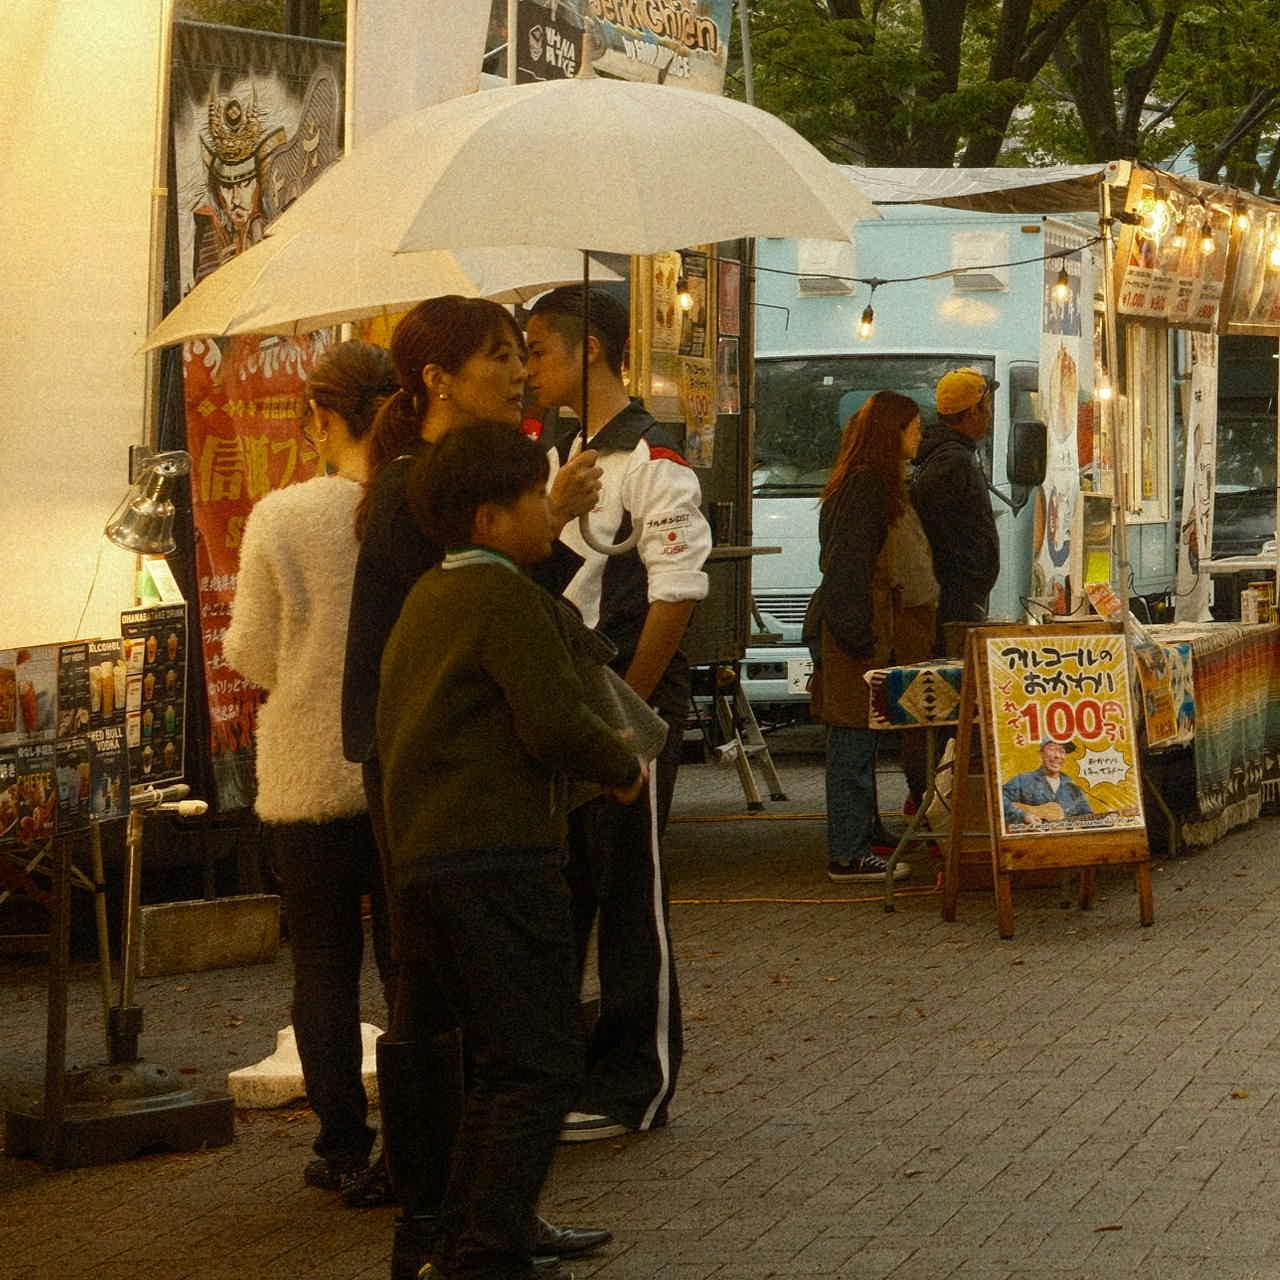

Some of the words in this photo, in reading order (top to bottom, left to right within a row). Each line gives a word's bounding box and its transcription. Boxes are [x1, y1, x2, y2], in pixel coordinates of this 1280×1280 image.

[89, 639, 120, 654] ALCOHOL
[1001, 647, 1113, 670] アルコールの
[1023, 671, 1115, 695] おかわり
